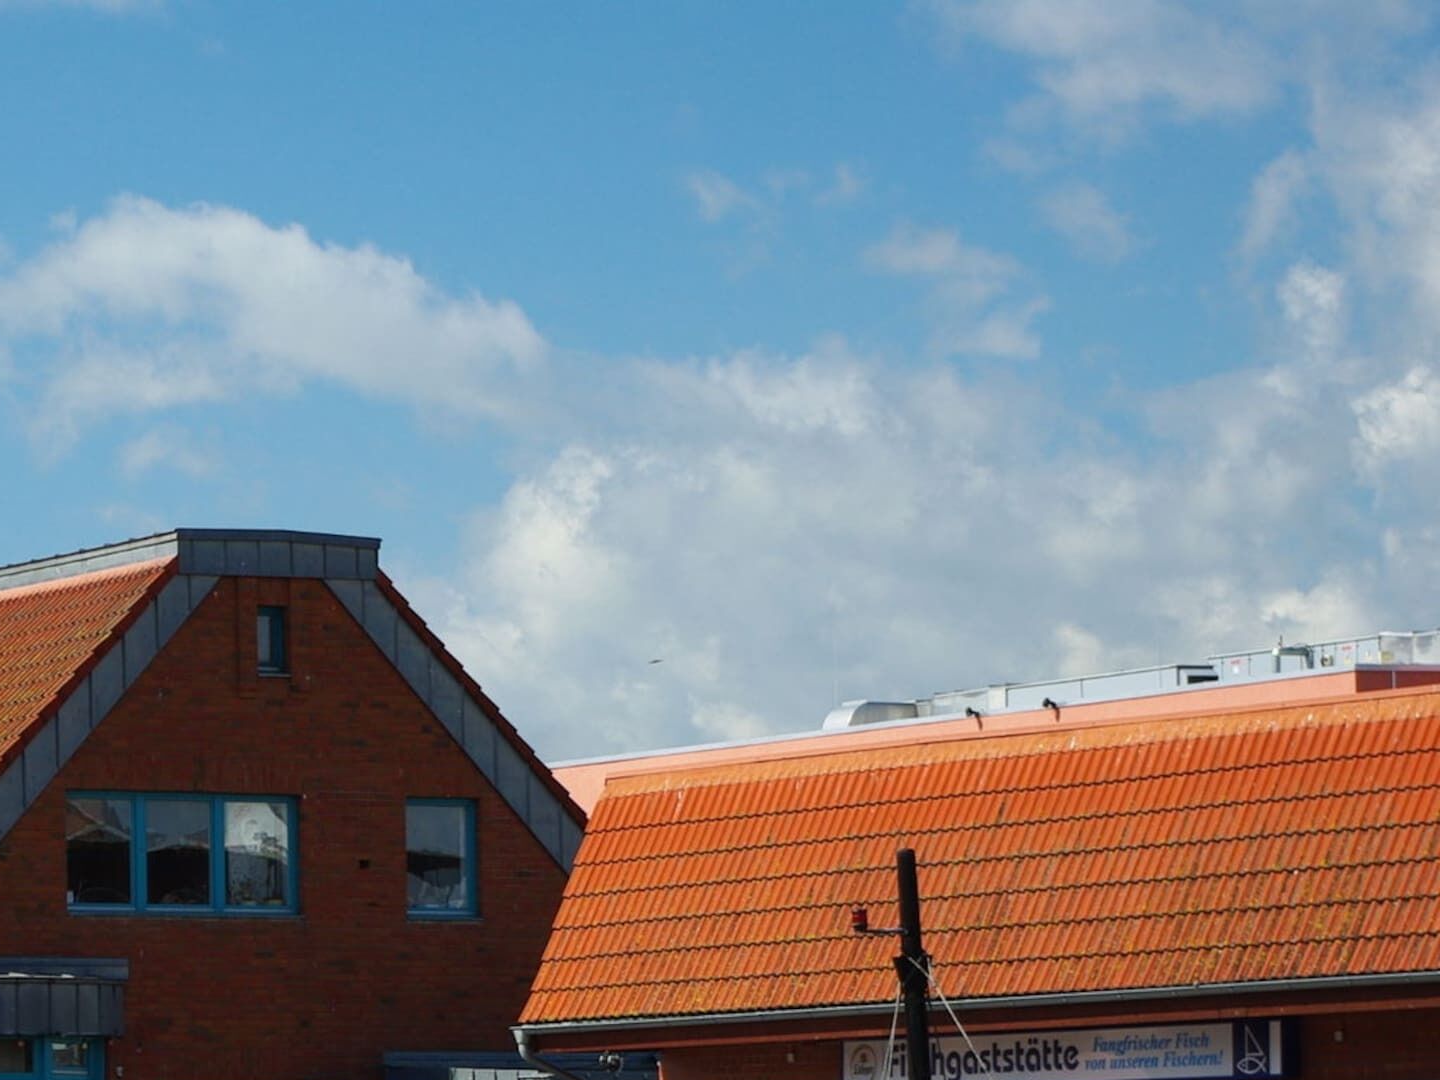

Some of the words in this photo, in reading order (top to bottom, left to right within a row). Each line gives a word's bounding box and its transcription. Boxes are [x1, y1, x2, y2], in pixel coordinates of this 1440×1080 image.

[1093, 1032, 1172, 1055] Fangfrischer
[1175, 1031, 1210, 1049] Fisch
[1085, 1057, 1106, 1070] von
[1110, 1055, 1159, 1070] unseren
[1163, 1050, 1225, 1068] Fischern!
